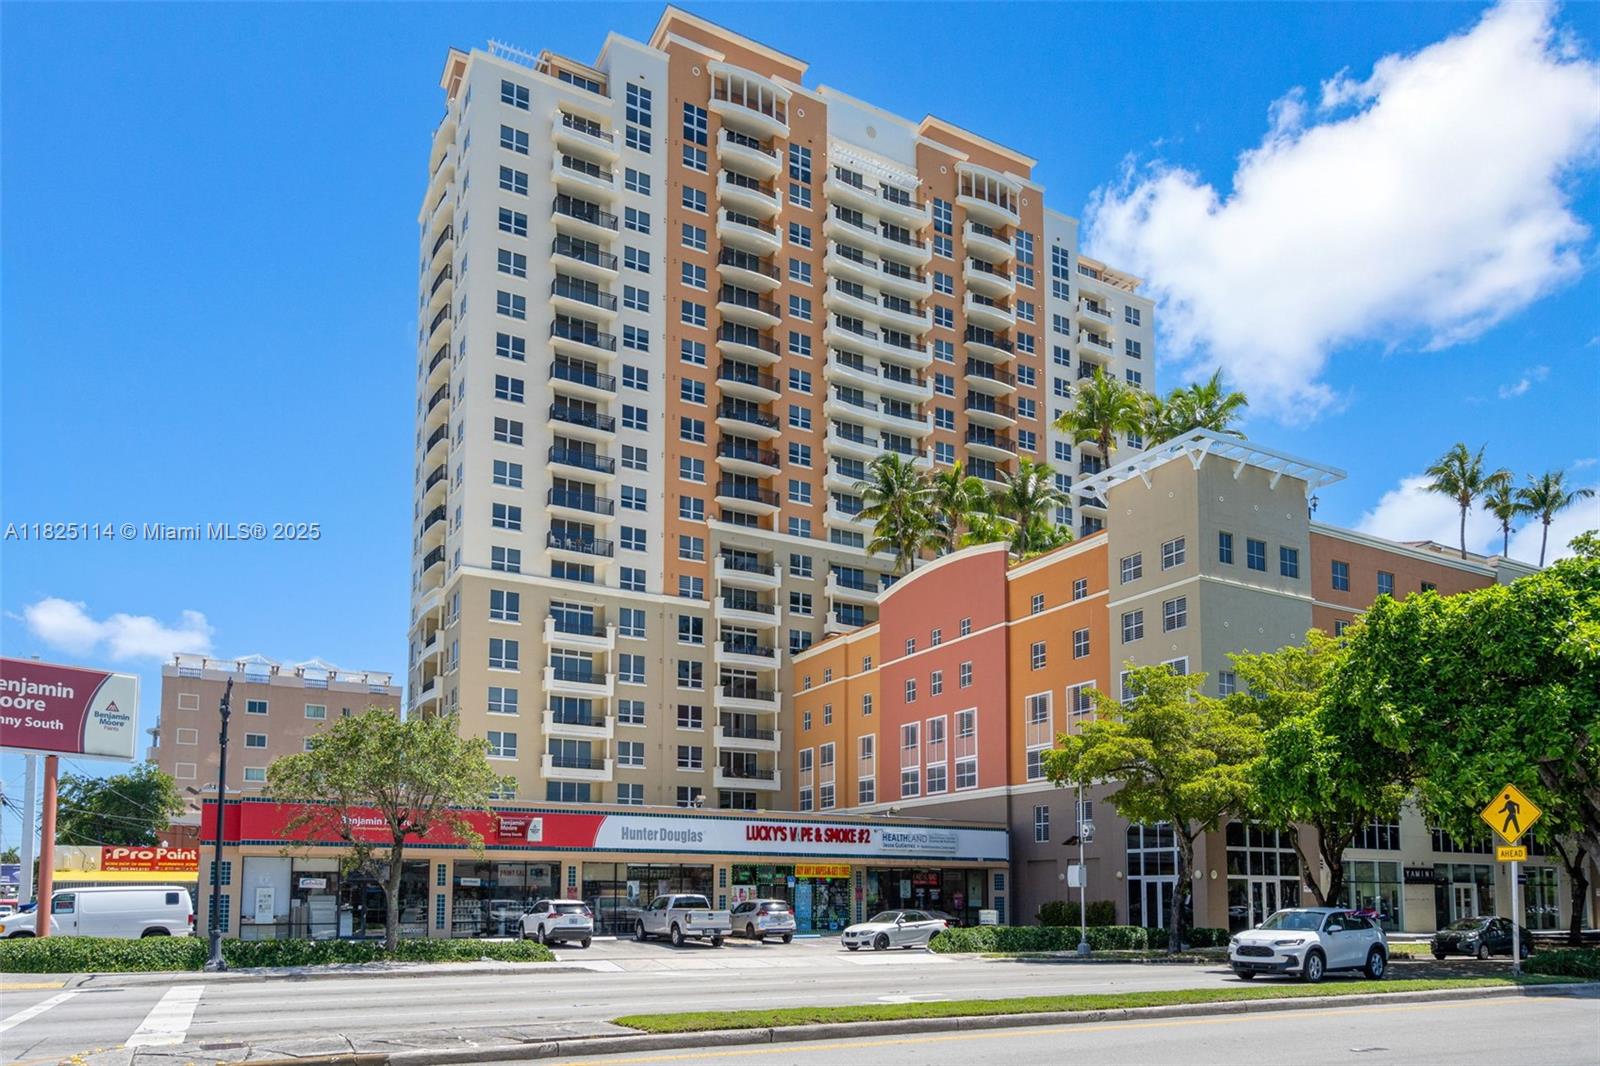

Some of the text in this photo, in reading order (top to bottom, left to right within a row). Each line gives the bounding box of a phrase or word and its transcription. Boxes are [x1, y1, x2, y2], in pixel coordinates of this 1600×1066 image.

[94, 710, 130, 721] Benjamin
[25, 716, 64, 730] South
[99, 718, 125, 727] Moore
[621, 826, 703, 843] Hunter Douglas
[746, 825, 787, 842] LUCKY'S
[814, 827, 823, 843] &
[824, 828, 857, 843] SMOKE
[858, 829, 871, 844] #2
[112, 847, 197, 860] Pro Paint
[1500, 850, 1524, 858] AHEAD
[1404, 870, 1434, 878] YAMINI
